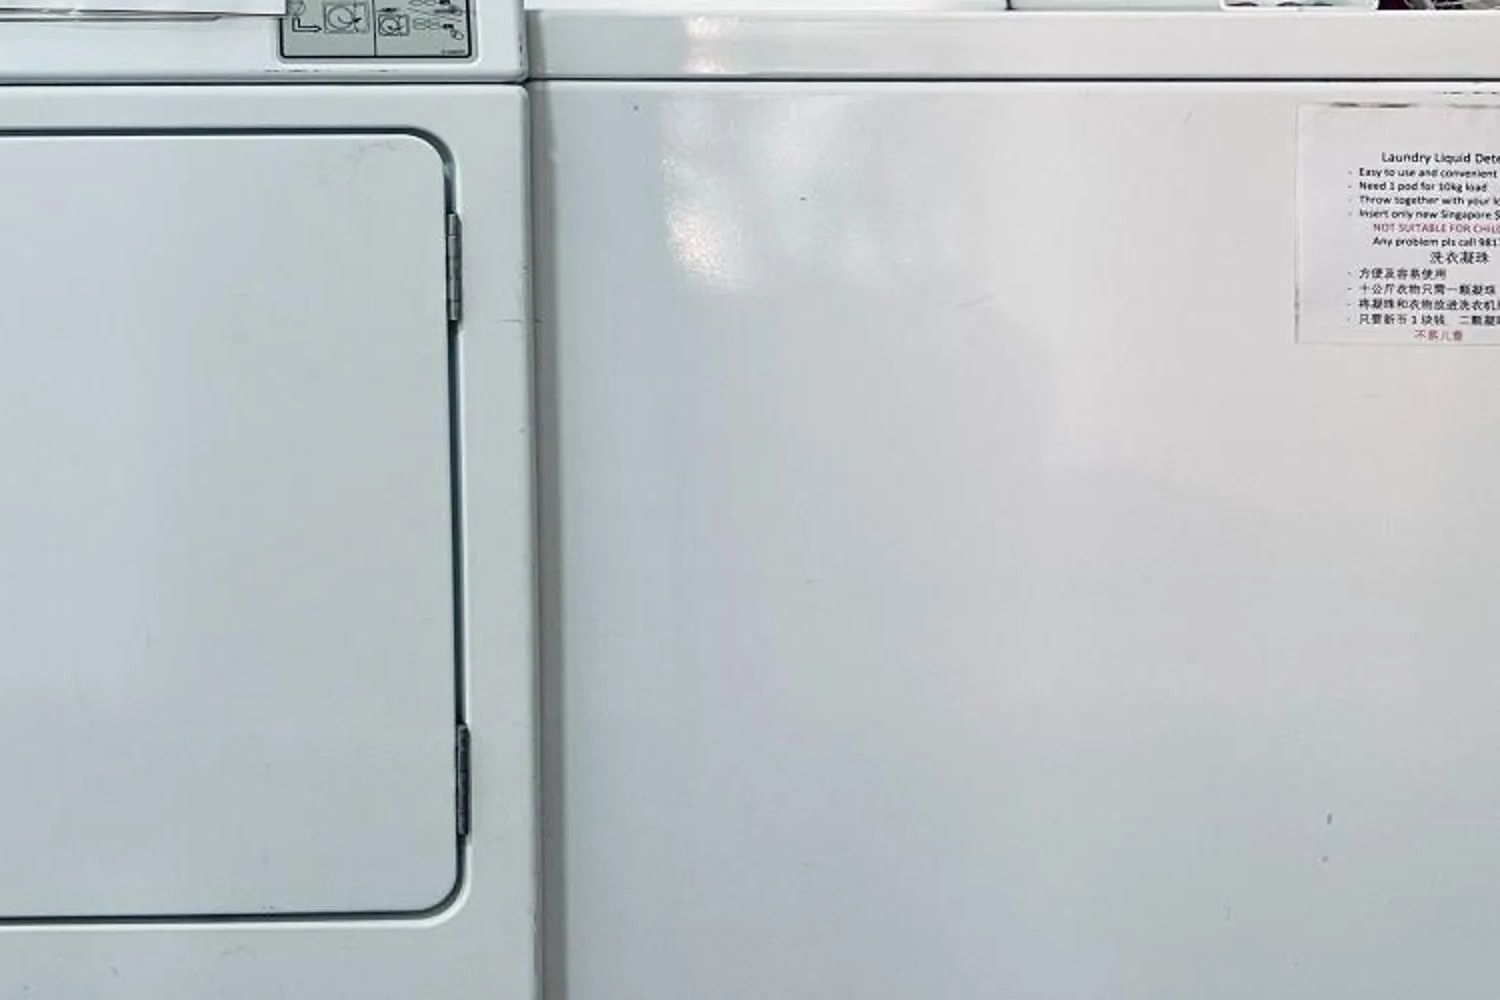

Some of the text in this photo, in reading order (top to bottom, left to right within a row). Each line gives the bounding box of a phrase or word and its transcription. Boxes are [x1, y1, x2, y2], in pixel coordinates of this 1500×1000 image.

[1381, 151, 1431, 164] Laundry
[1434, 151, 1471, 164] Liquid
[1359, 167, 1497, 179] Easy to use and convenient
[1359, 181, 1387, 191] Need
[1397, 181, 1419, 192] pod
[1420, 181, 1435, 191] for
[1360, 195, 1392, 205] Throw
[1395, 195, 1440, 206] together
[1441, 195, 1465, 205] with
[1467, 197, 1489, 207] your
[1360, 209, 1389, 219] Insert
[1391, 209, 1413, 220] only
[1415, 211, 1439, 219] new
[1441, 209, 1492, 221] Singapore
[1373, 223, 1396, 232] NOT
[1398, 223, 1447, 233] SUITABLE
[1449, 223, 1471, 233] FOR
[1372, 236, 1393, 247] Any
[1395, 237, 1439, 247] problem
[1441, 237, 1456, 247] pls
[1458, 237, 1477, 247] call
